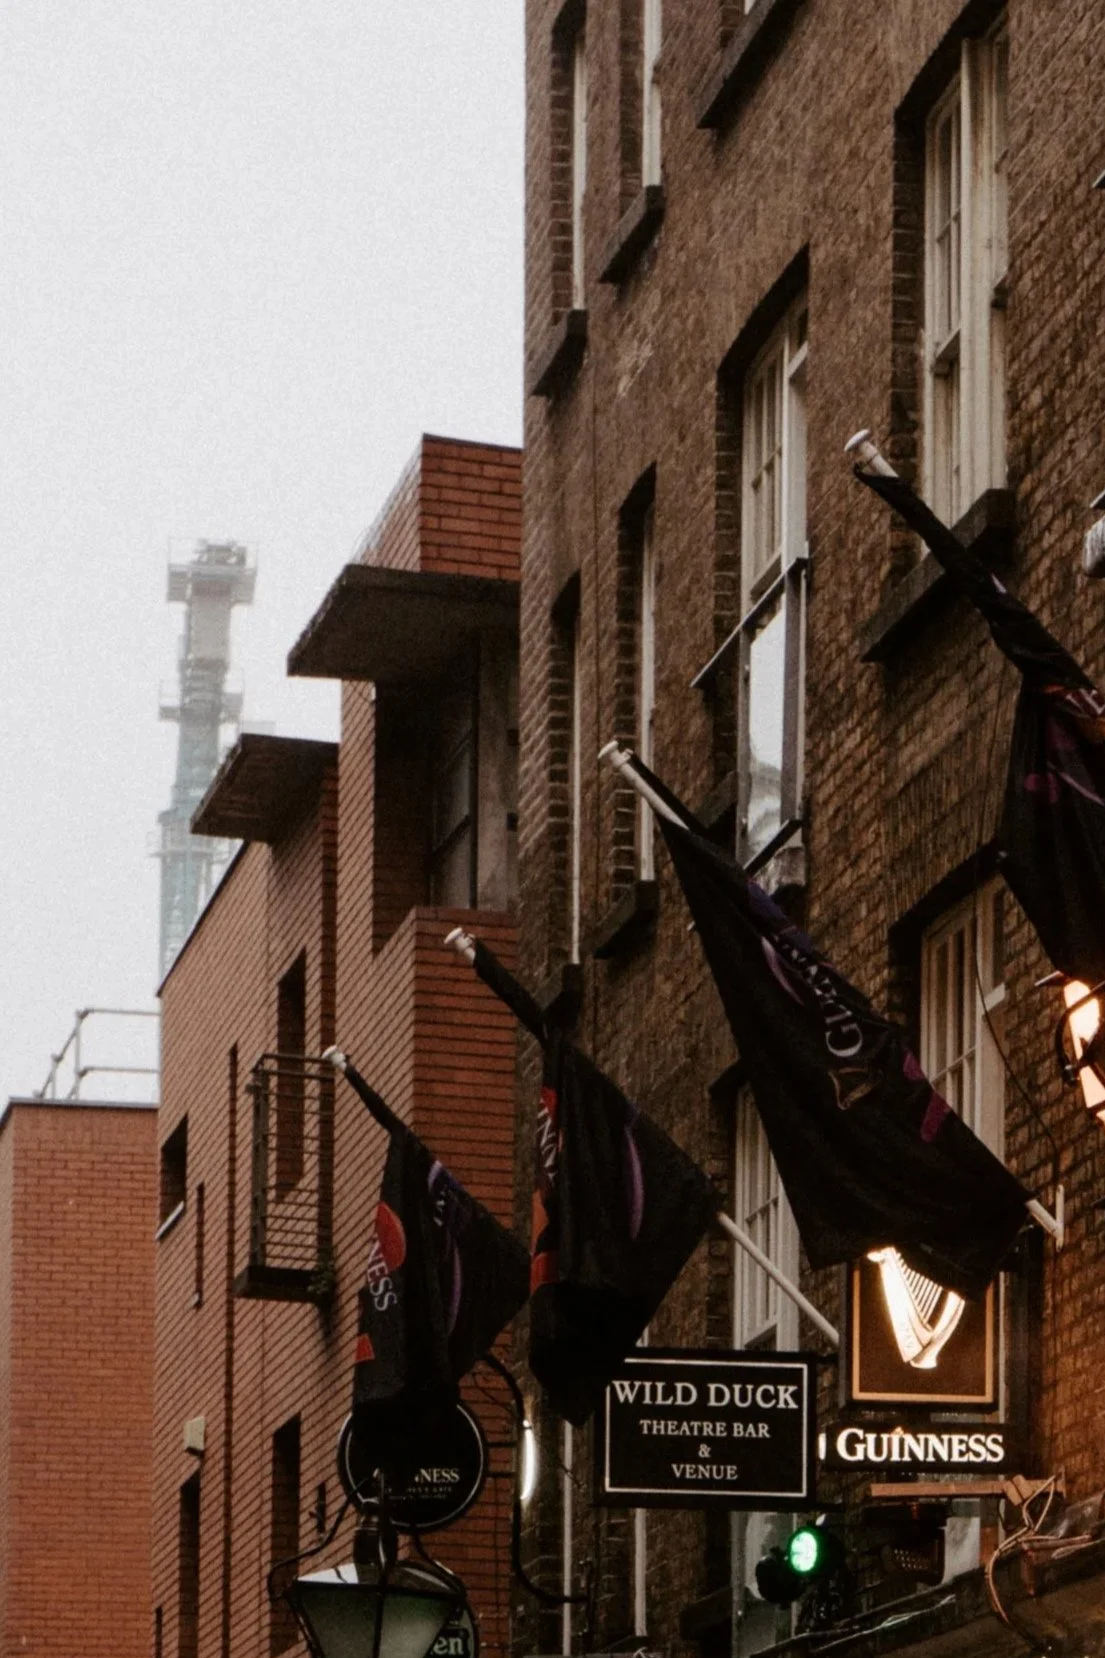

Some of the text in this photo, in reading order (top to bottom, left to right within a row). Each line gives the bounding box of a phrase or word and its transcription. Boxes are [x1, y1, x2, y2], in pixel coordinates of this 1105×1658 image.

[611, 1379, 800, 1410] WILD DUCK
[638, 1418, 772, 1439] THEATRE BAR
[697, 1442, 713, 1459] &
[836, 1427, 1006, 1463] GUINNESS
[670, 1463, 739, 1480] VENUE
